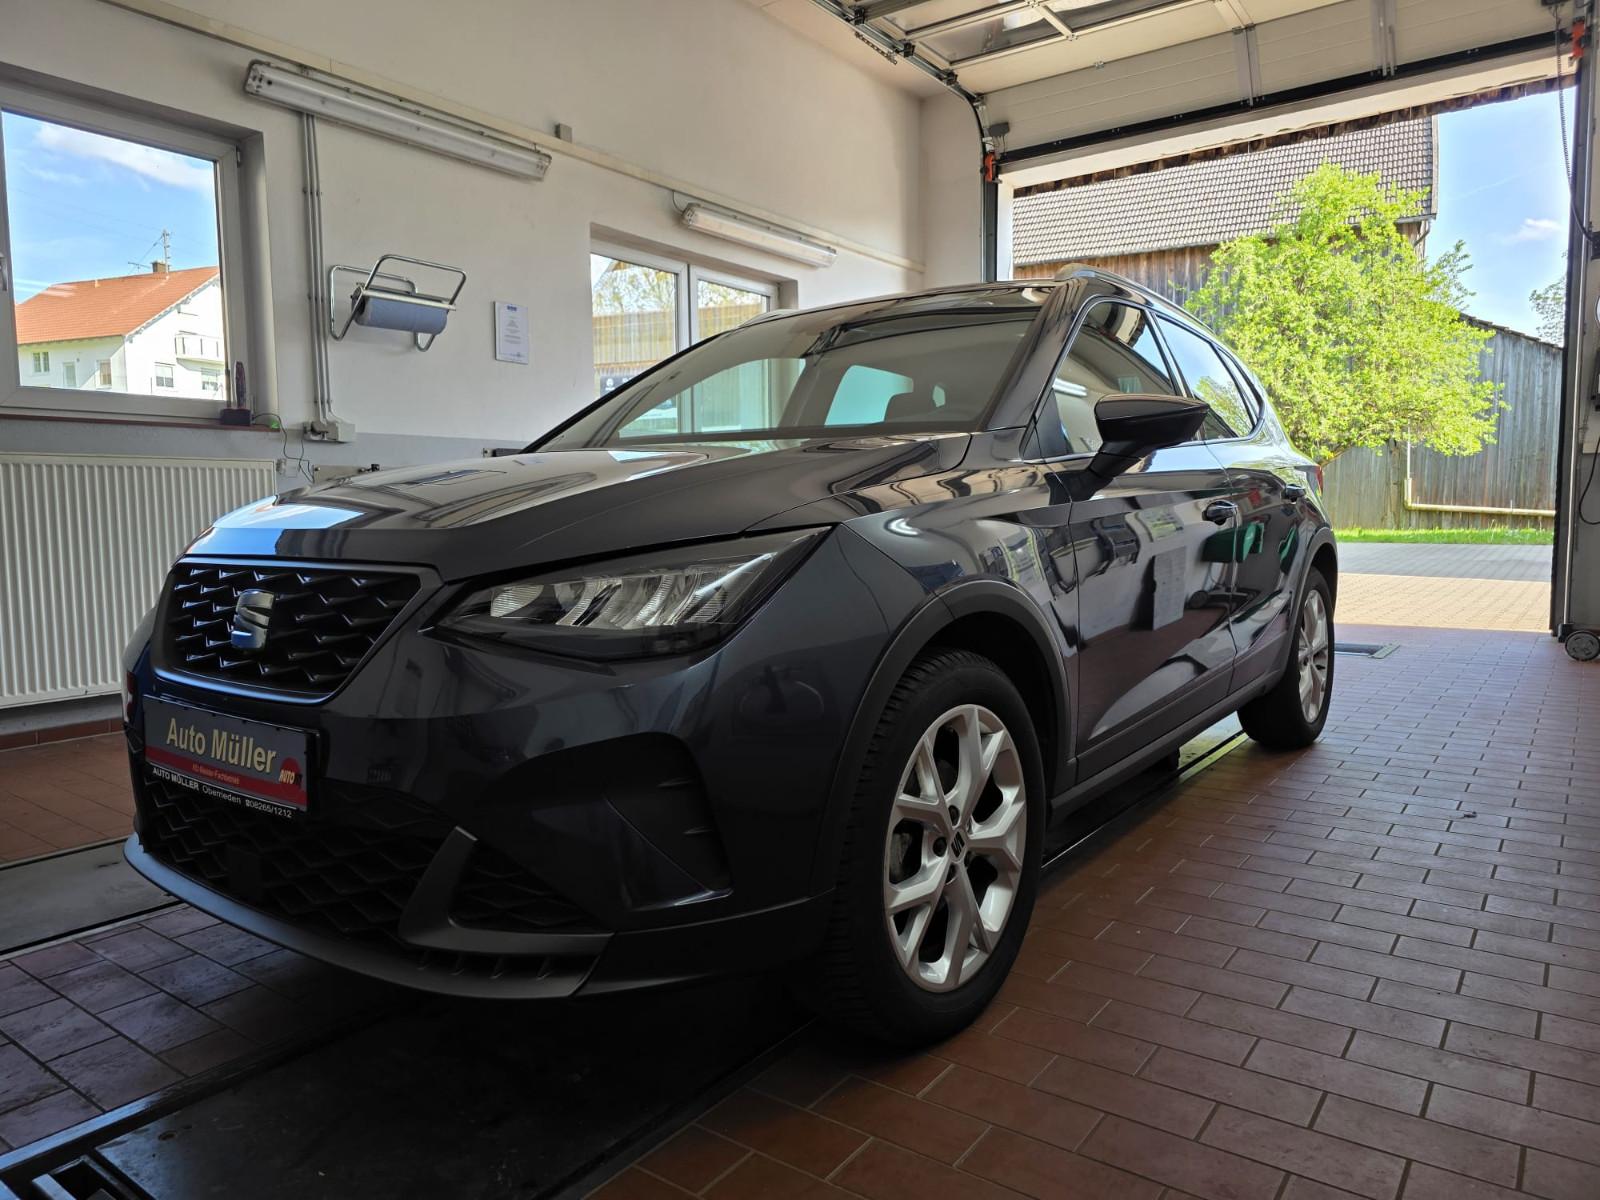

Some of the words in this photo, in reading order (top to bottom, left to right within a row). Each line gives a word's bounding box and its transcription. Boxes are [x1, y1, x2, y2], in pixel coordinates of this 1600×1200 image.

[166, 717, 206, 754] Auto
[211, 728, 277, 773] Müller
[152, 767, 171, 780] AUTO
[171, 773, 200, 791] MÜLLER
